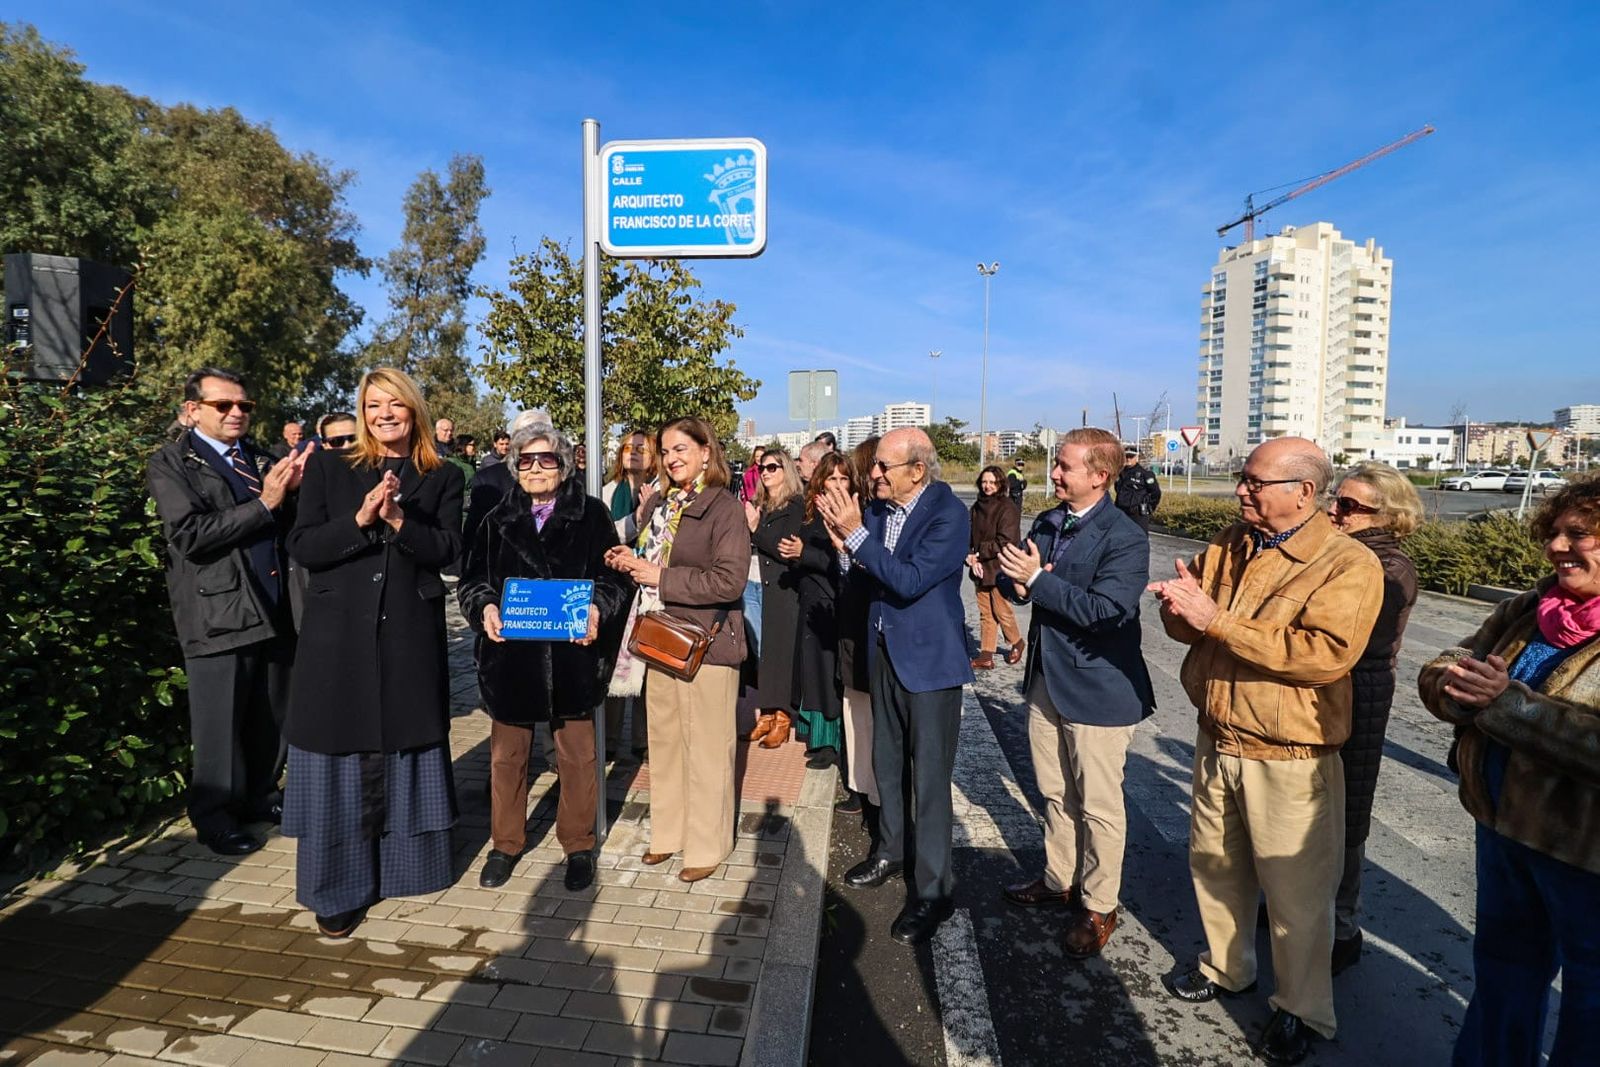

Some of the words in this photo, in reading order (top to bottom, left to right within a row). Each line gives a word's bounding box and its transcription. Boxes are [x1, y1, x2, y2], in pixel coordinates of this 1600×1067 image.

[612, 177, 643, 186] CALLE
[613, 194, 684, 208] ARQUITECTO
[613, 216, 676, 229] FRANCISCO
[678, 216, 694, 228] DE
[697, 215, 711, 227] LA
[713, 214, 751, 227] CORTE
[505, 607, 548, 616] ARQUITECTO
[504, 620, 541, 630] FRANCISCO
[543, 621, 552, 630] DE
[554, 621, 563, 630] LA
